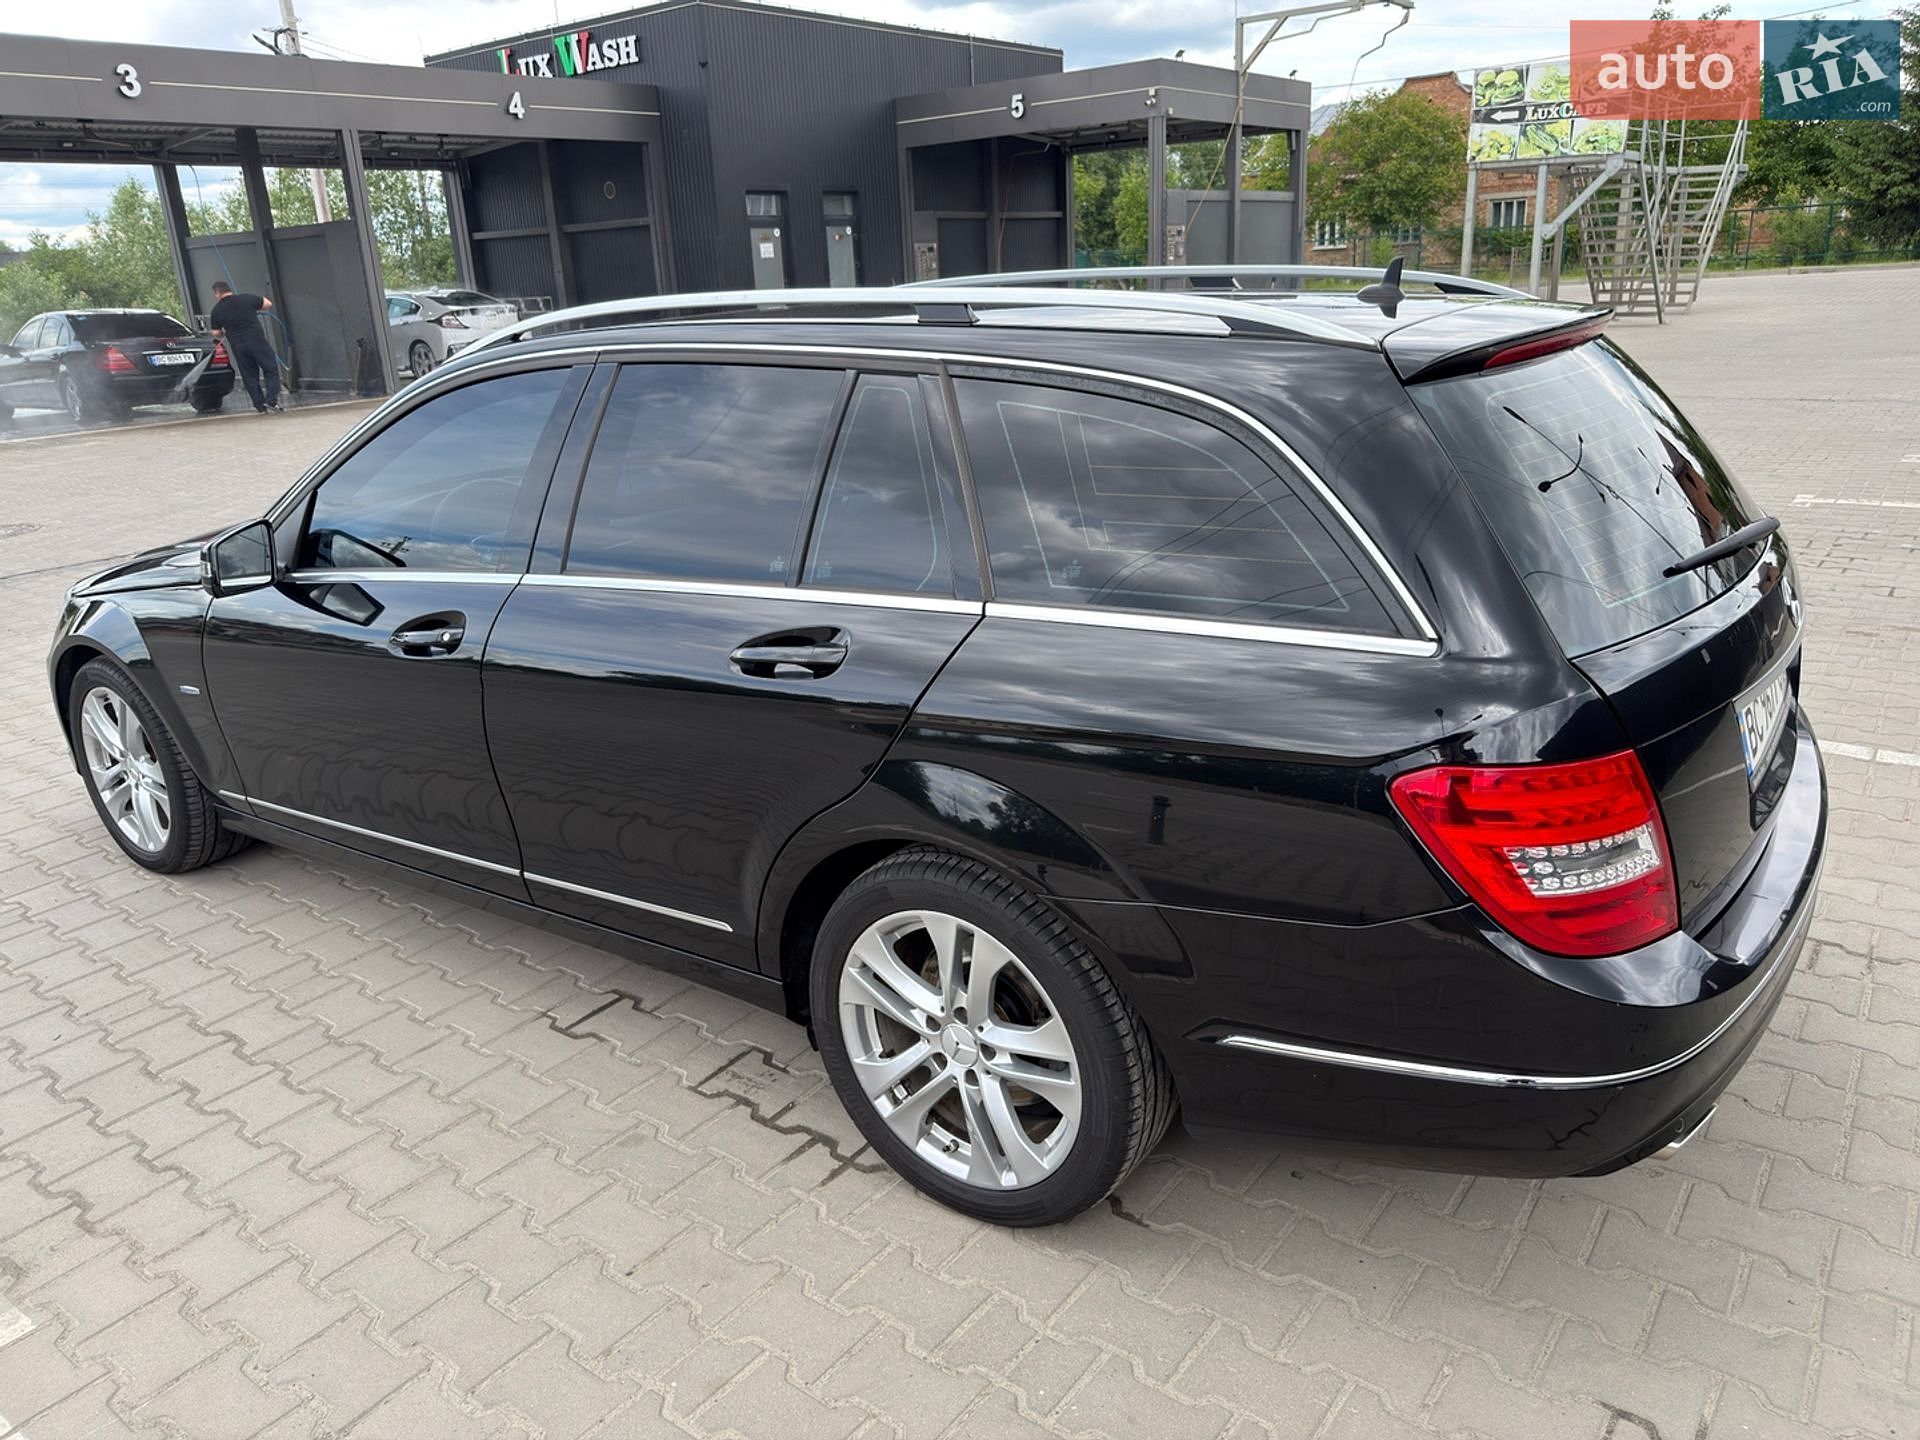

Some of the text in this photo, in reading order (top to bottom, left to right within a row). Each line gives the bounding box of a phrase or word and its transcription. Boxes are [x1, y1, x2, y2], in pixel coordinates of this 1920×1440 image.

[554, 30, 639, 77] WASH
[116, 63, 142, 97] 3
[509, 91, 525, 119] 4
[1011, 93, 1024, 118] 5
